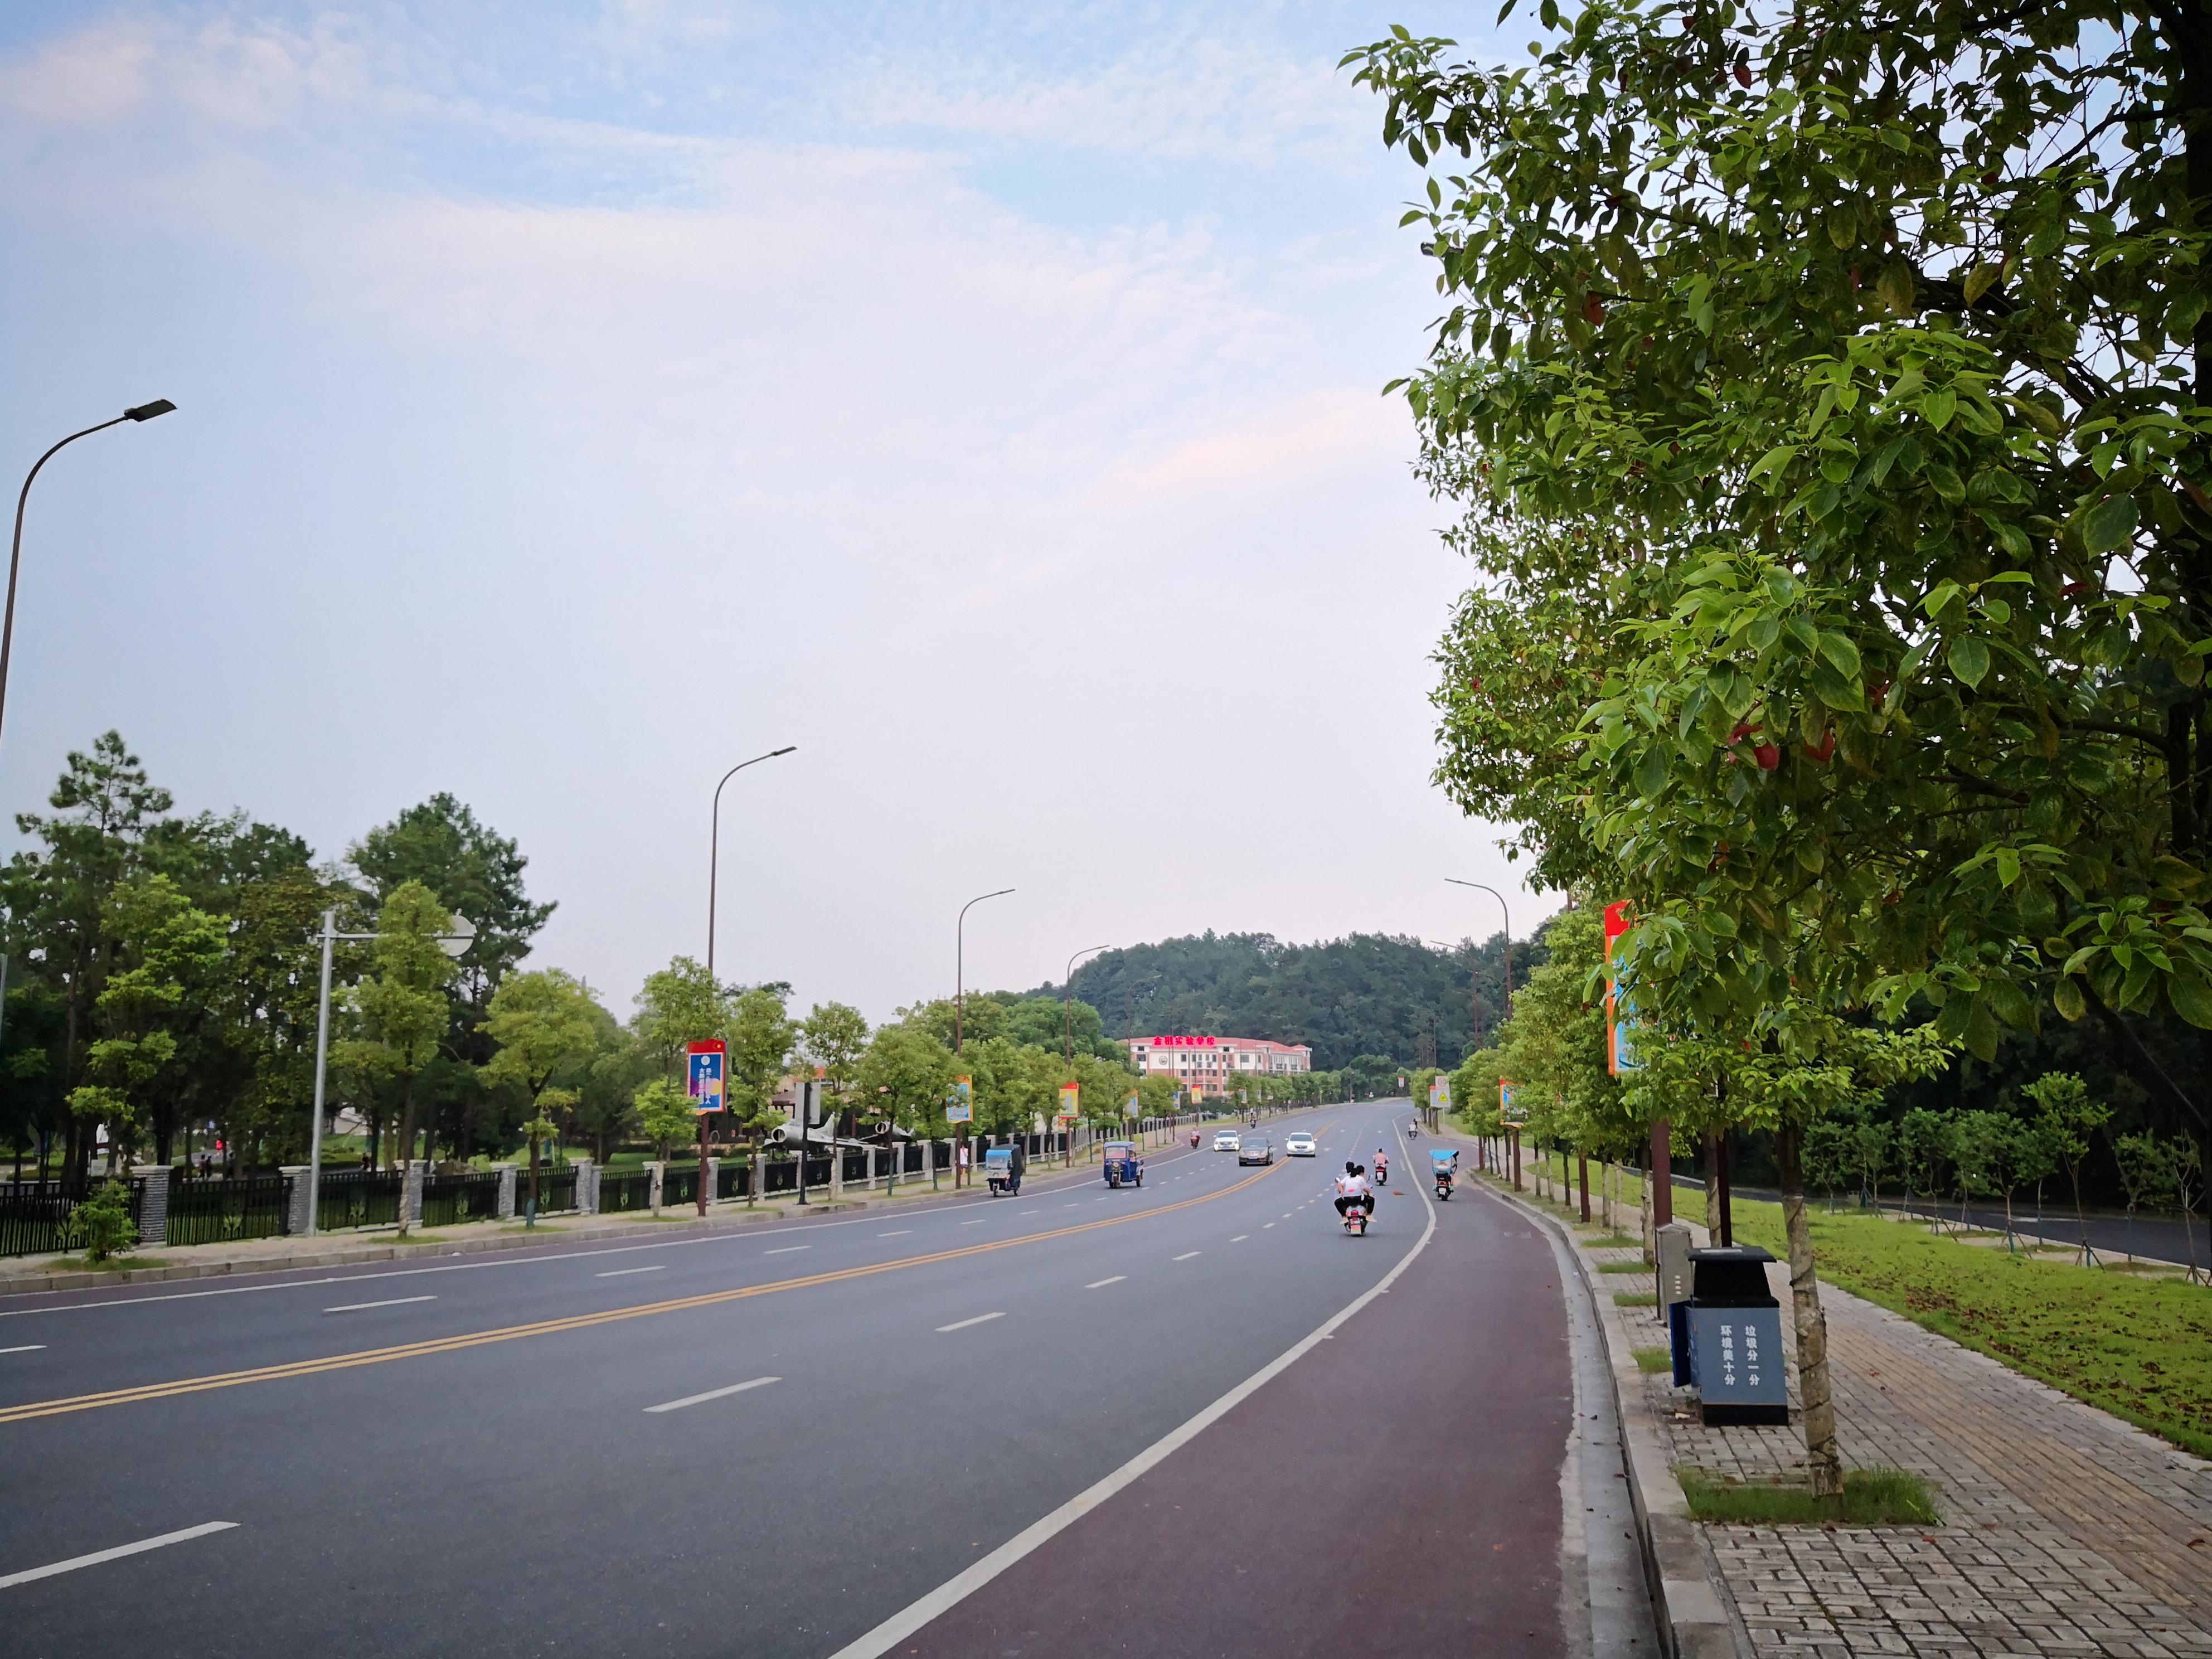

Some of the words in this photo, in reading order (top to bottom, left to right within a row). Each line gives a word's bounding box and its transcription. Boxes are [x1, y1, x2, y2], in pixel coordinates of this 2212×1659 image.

[1720, 1325, 1735, 1385] 环境美十分
[1745, 1325, 1759, 1386] 垃圾分一分
